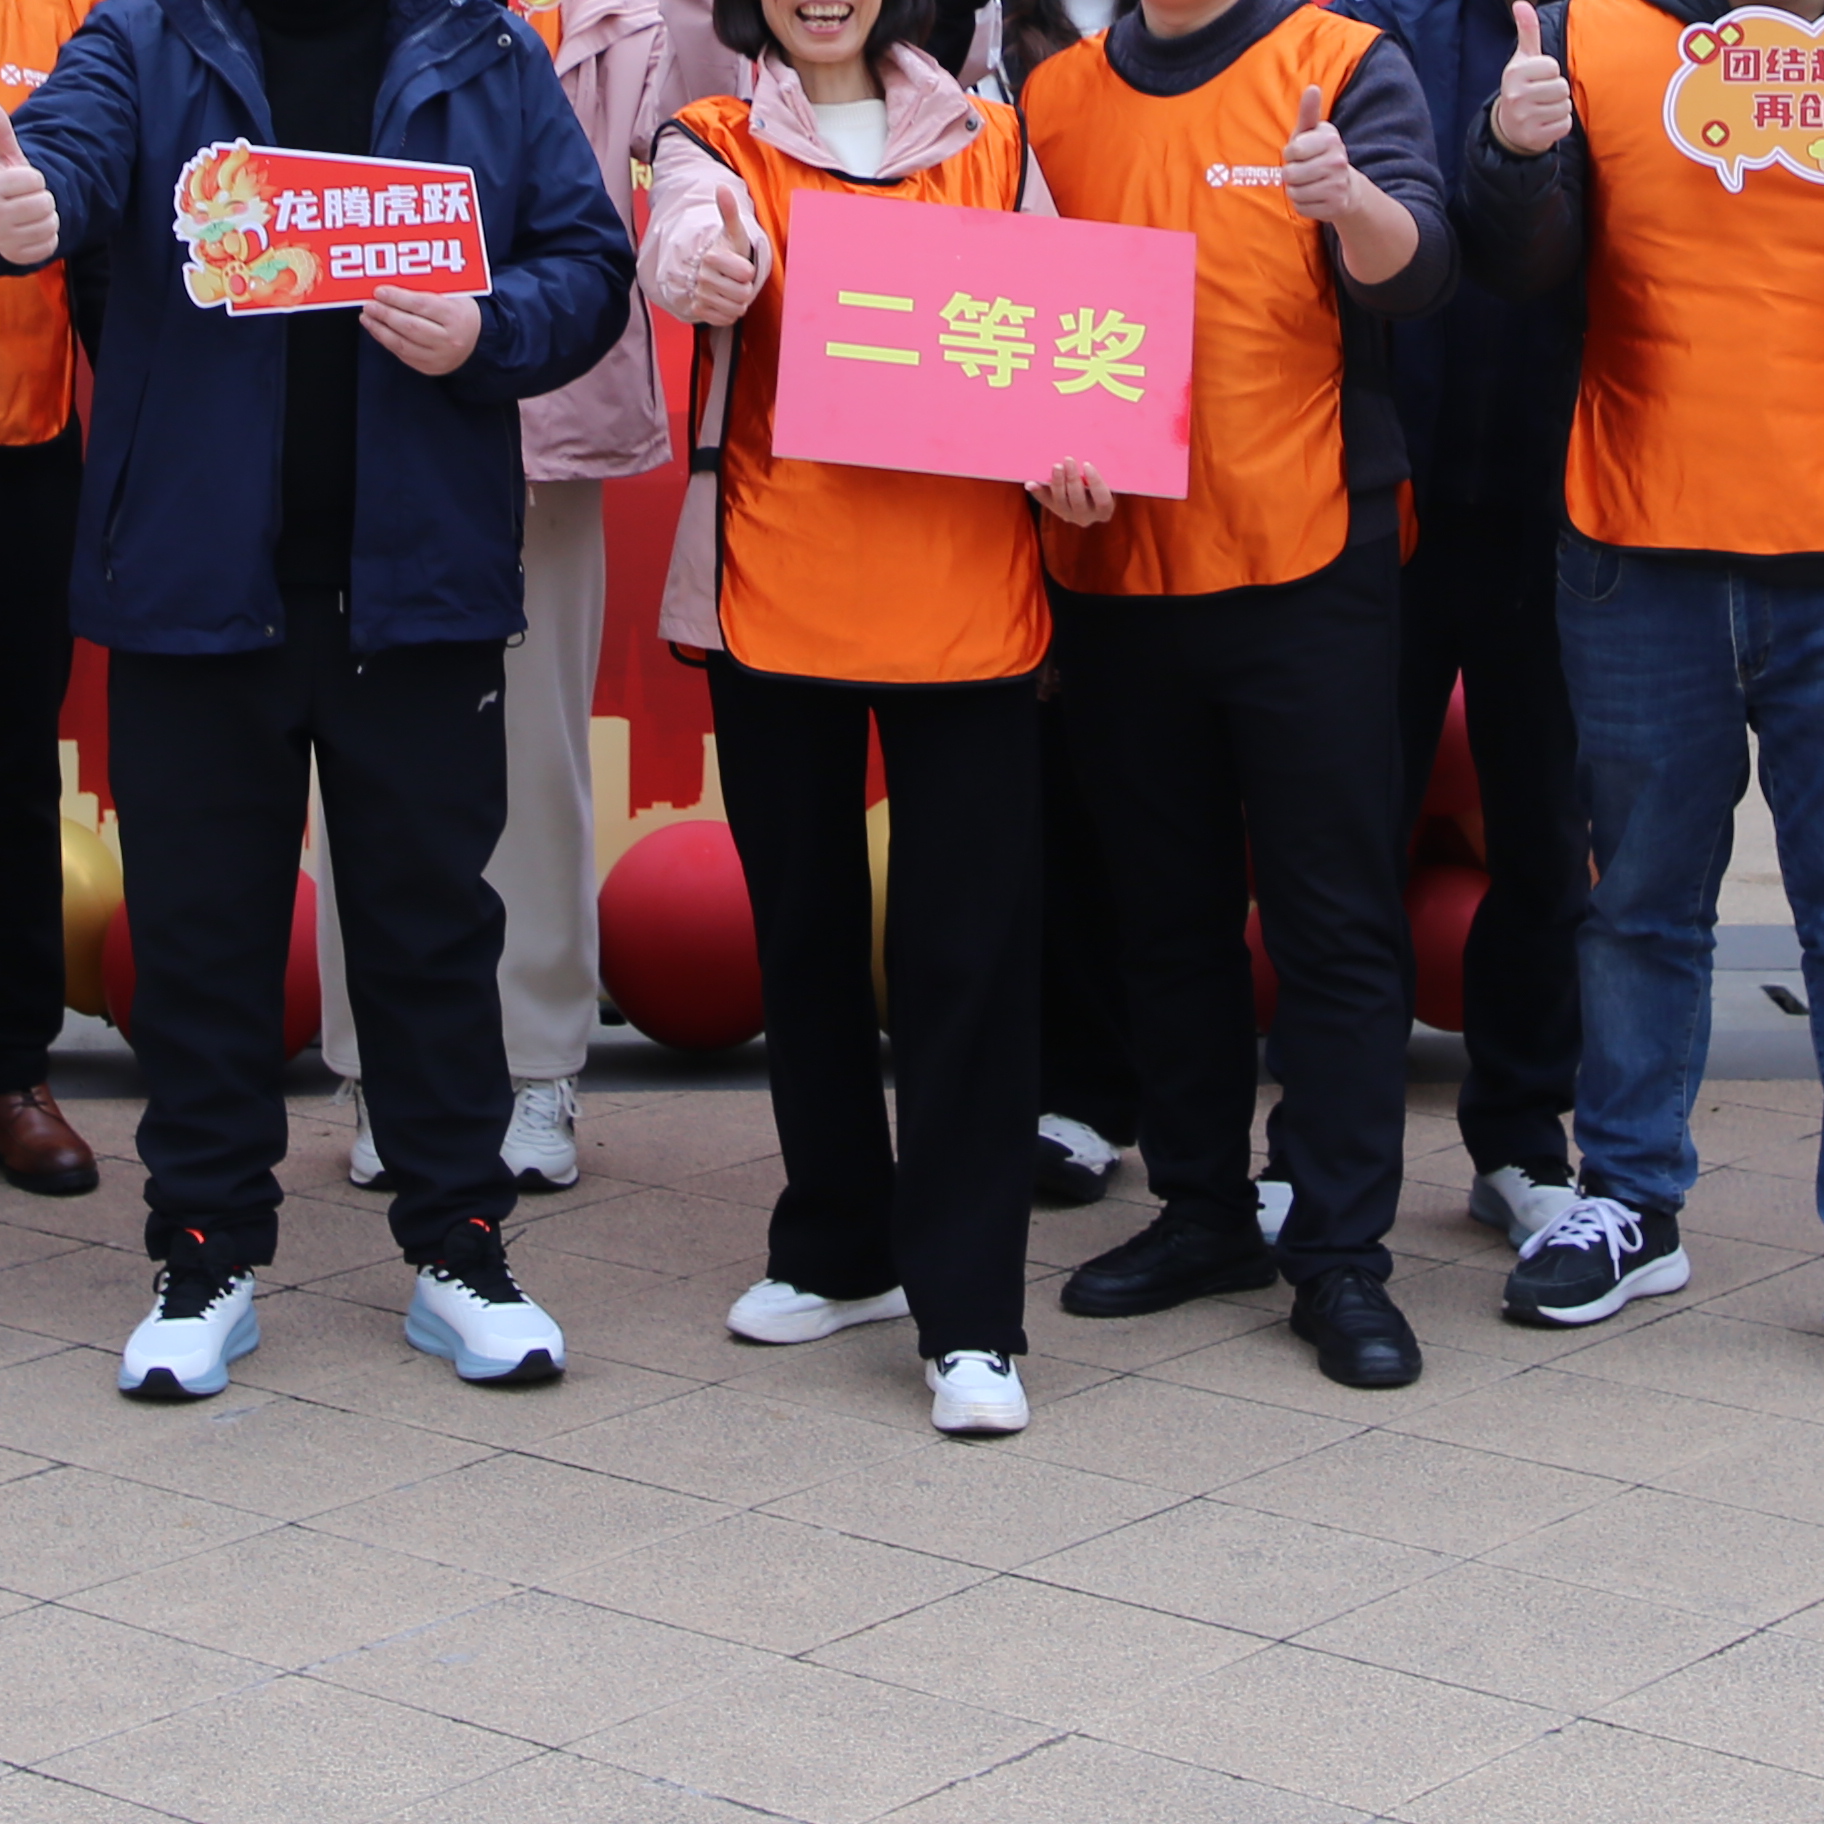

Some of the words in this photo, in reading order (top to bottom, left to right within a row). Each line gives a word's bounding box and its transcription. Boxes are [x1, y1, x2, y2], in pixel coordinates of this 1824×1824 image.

[272, 180, 472, 233] 龙腾虎跃
[329, 238, 467, 280] 2024
[825, 289, 1147, 404] 二等奖
